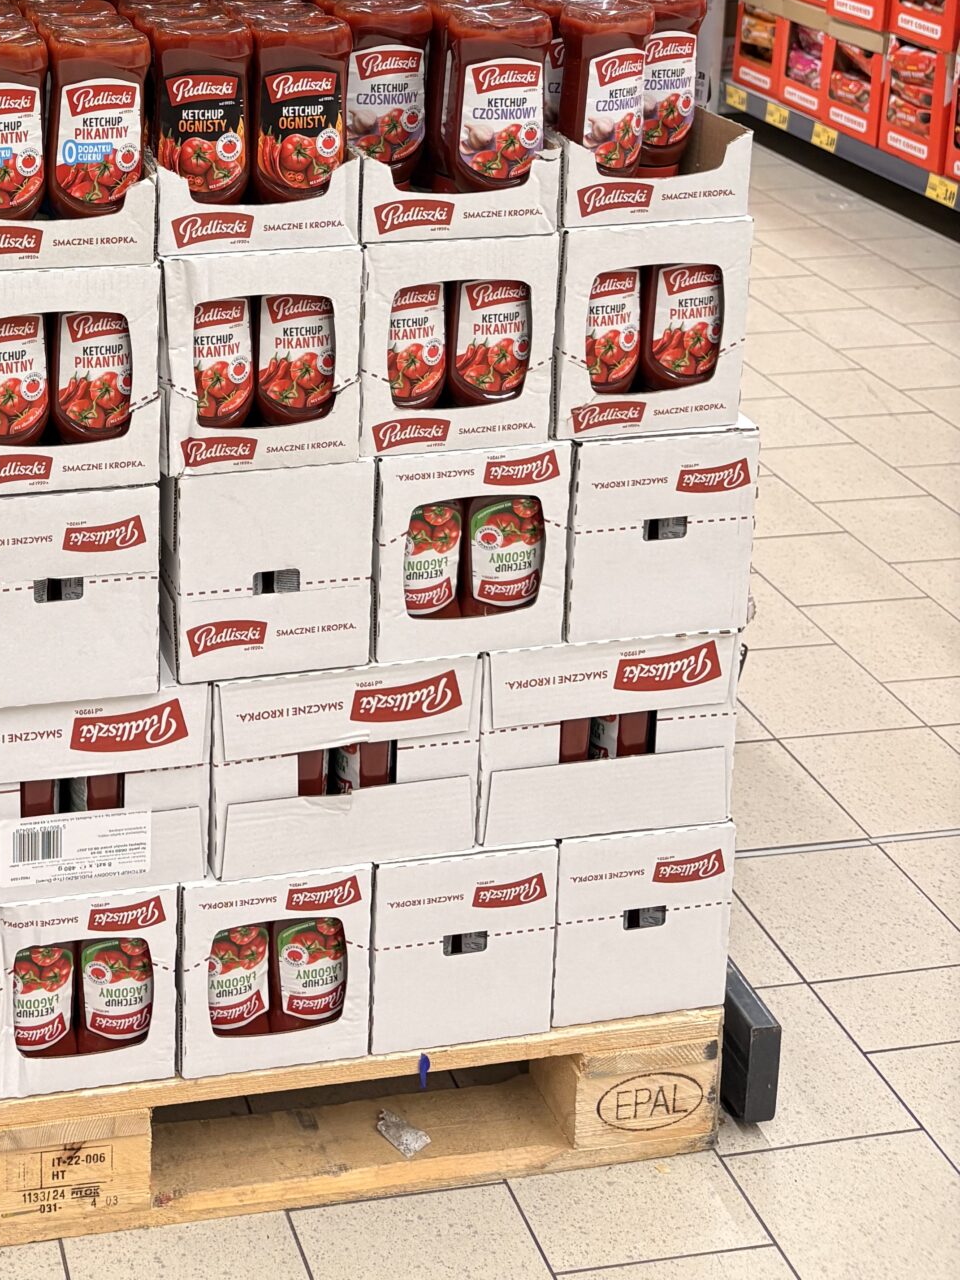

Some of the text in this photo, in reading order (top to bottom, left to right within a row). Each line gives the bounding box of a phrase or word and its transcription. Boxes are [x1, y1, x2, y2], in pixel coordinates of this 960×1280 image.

[900, 17, 939, 35] SOFT COOKIES
[488, 97, 527, 107] KETCHUP
[473, 107, 537, 120] CZOSNKOWY
[360, 676, 455, 717] Pudliszki
[237, 705, 284, 722] KROPKA.
[293, 700, 344, 716] SMACZNE
[615, 1084, 689, 1120] EPAL
[52, 1153, 106, 1167] IT-22-006
[52, 1170, 67, 1181] HT
[22, 1189, 65, 1203] 1133/24
